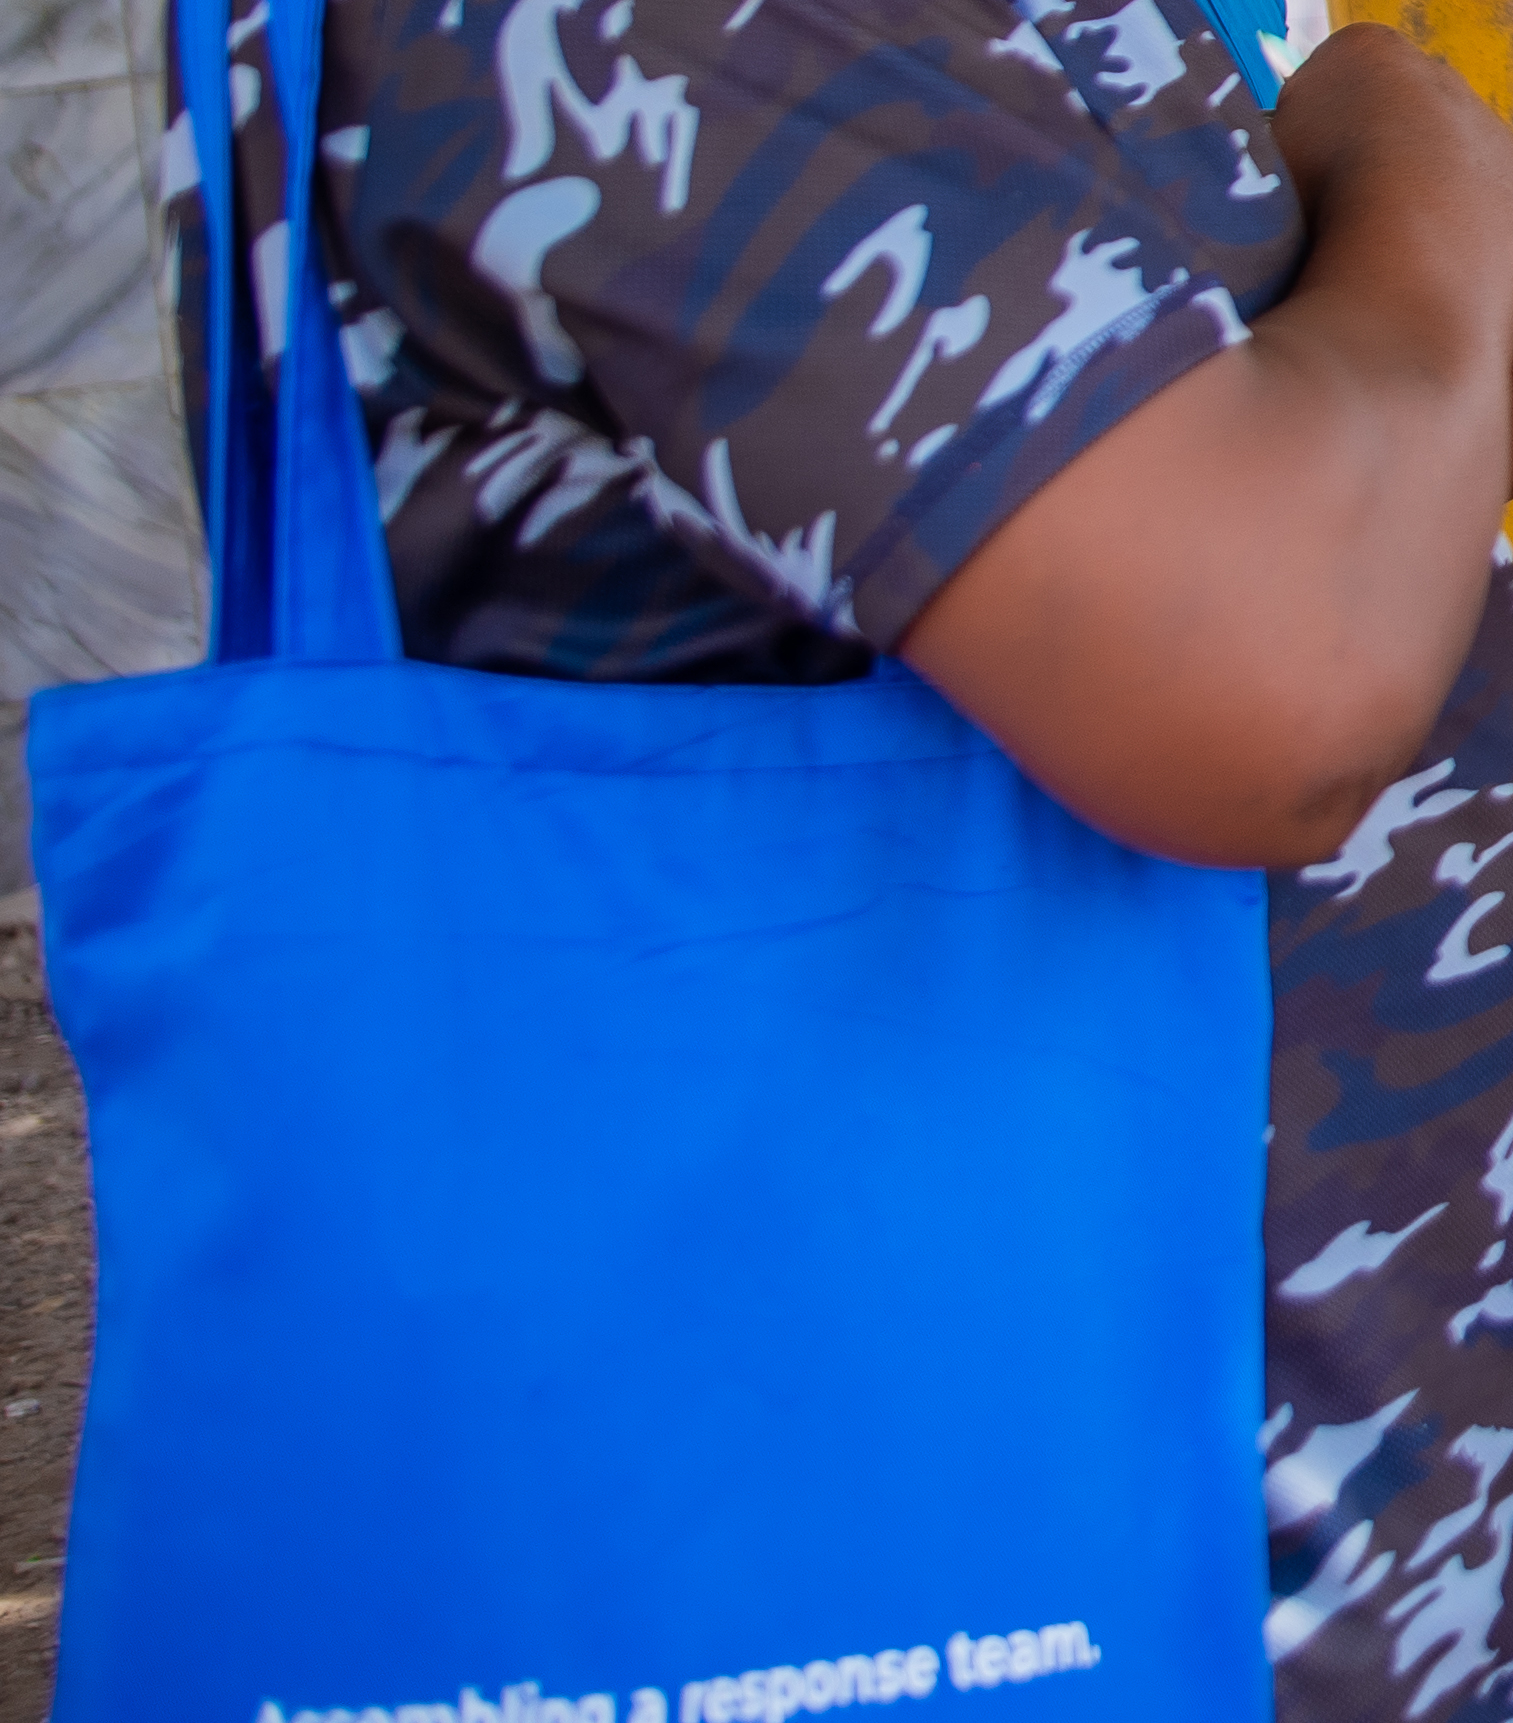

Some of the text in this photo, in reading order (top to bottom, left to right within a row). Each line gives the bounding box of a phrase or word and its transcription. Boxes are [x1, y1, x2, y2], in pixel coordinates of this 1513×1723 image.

[627, 1686, 669, 1723] a
[679, 1643, 941, 1723] response
[945, 1619, 1101, 1692] team.
